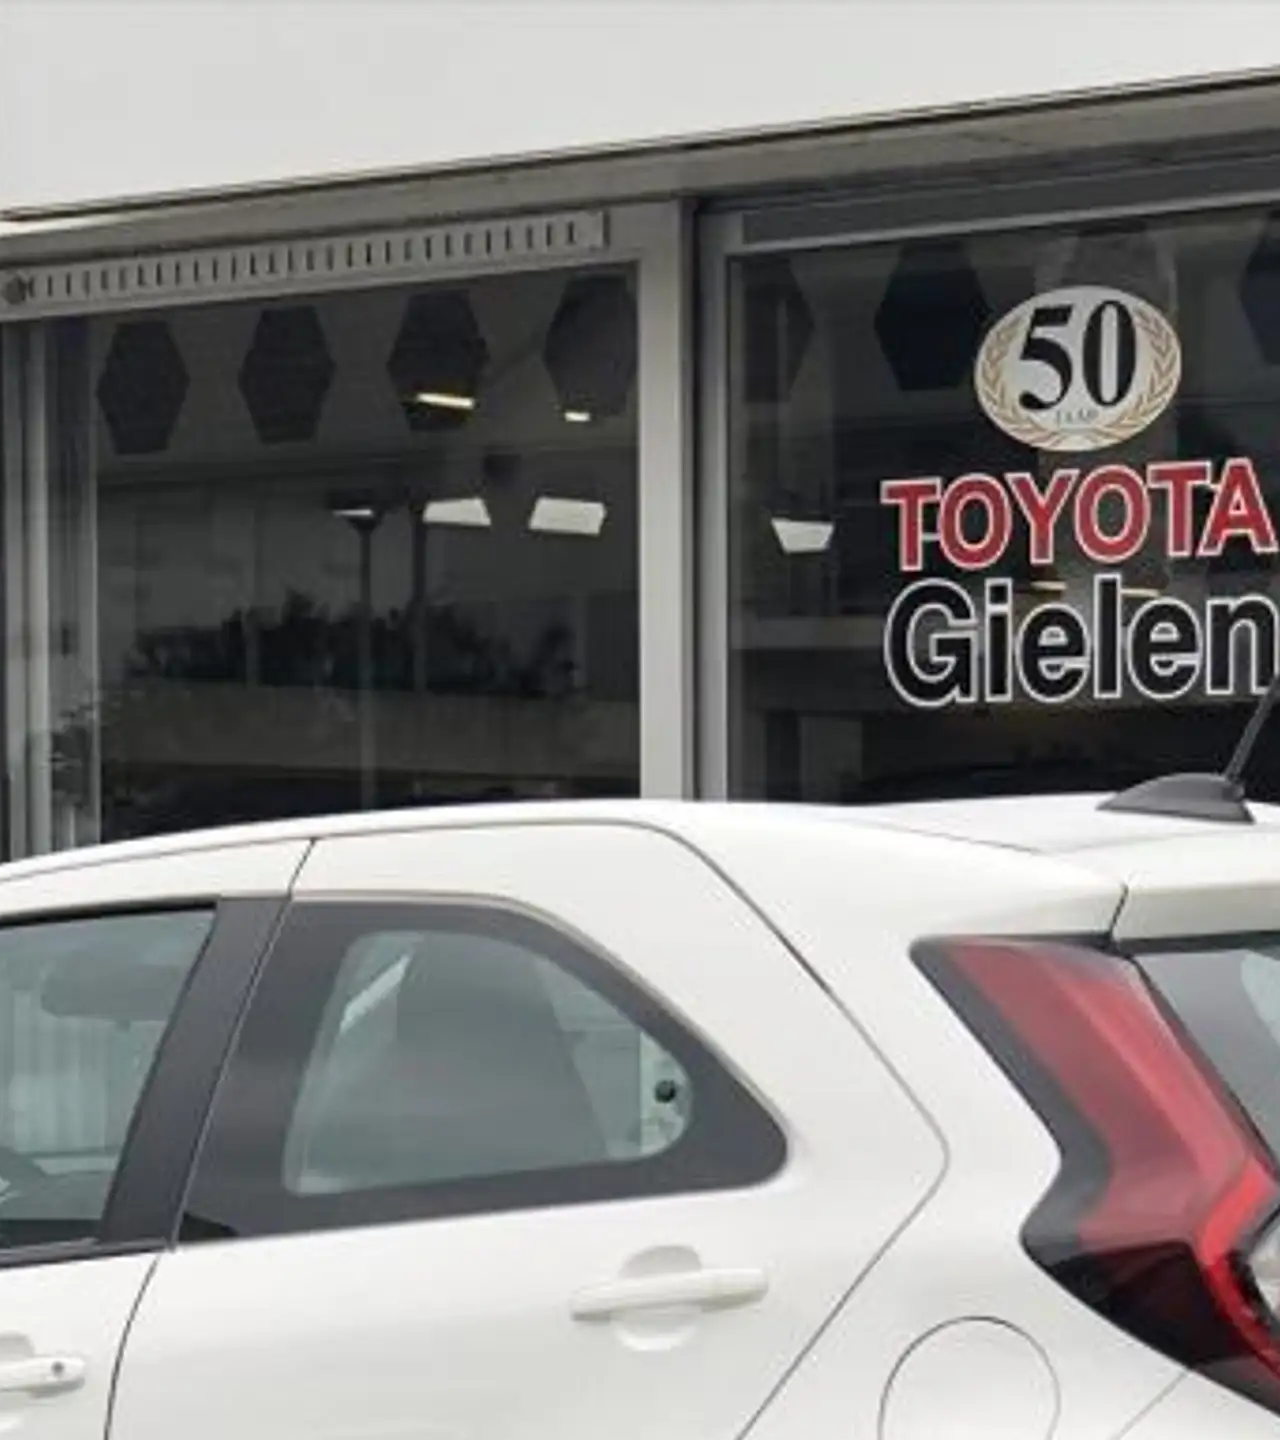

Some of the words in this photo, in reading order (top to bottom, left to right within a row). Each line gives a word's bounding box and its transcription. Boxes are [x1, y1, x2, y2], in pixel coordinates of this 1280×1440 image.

[1019, 301, 1138, 411] 50
[880, 457, 1280, 572] TOYOTA
[883, 572, 1280, 707] Gielen
